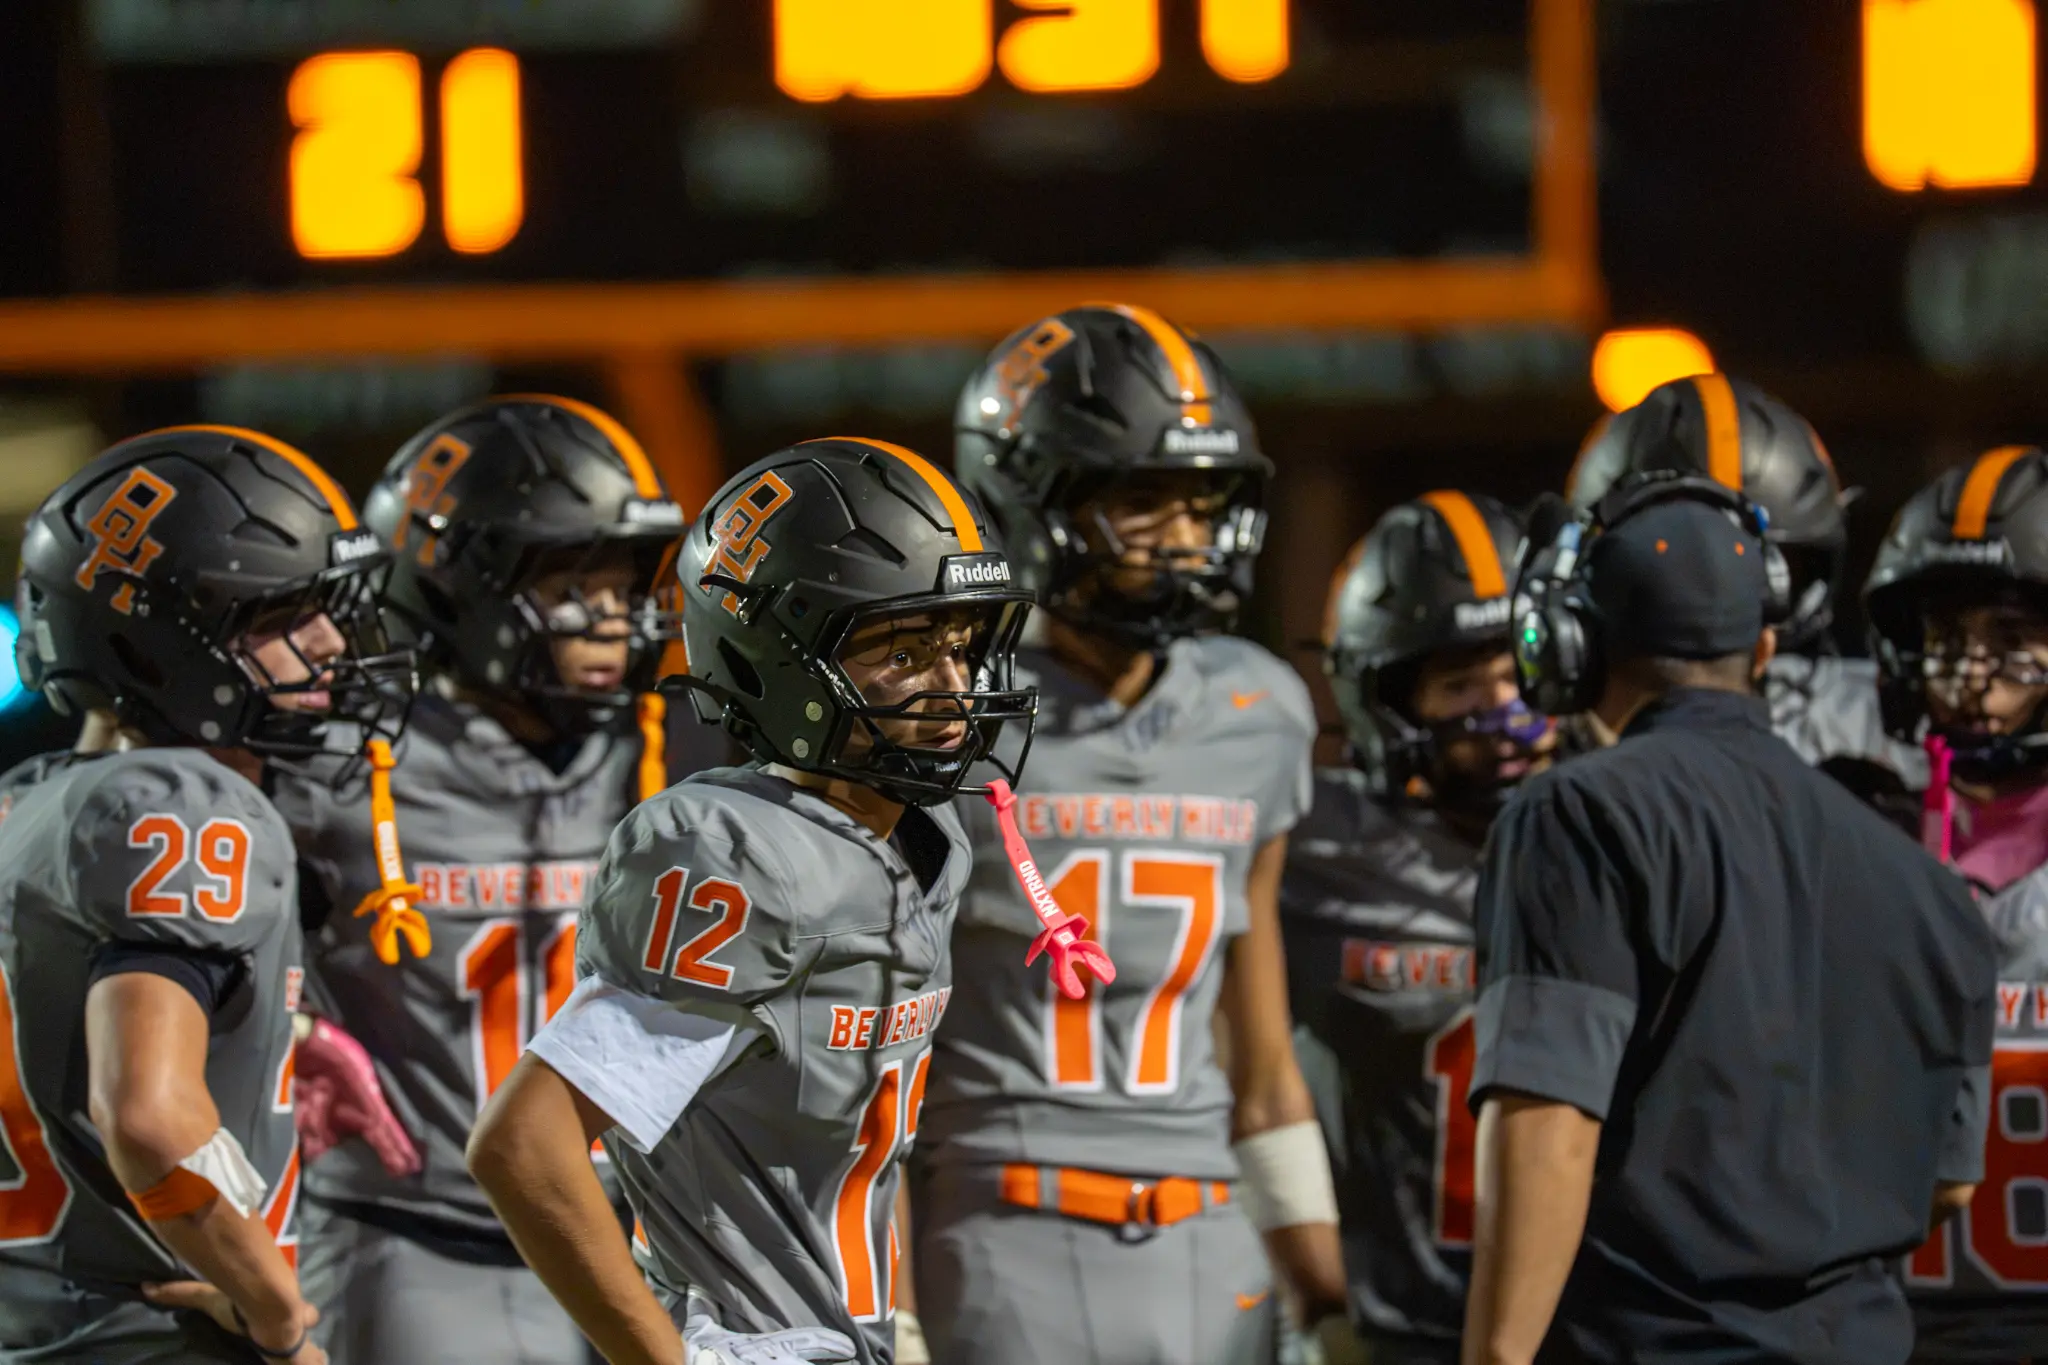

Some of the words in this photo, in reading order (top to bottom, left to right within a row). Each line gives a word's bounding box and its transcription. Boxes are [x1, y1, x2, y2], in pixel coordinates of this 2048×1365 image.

[949, 561, 1011, 584] Riddell
[993, 791, 1176, 840] EVERLY
[125, 812, 252, 924] 29
[1019, 860, 1060, 919] NXTRND
[641, 865, 753, 991] 12
[1042, 848, 1226, 1096] 17
[826, 990, 938, 1051] BEVERLY
